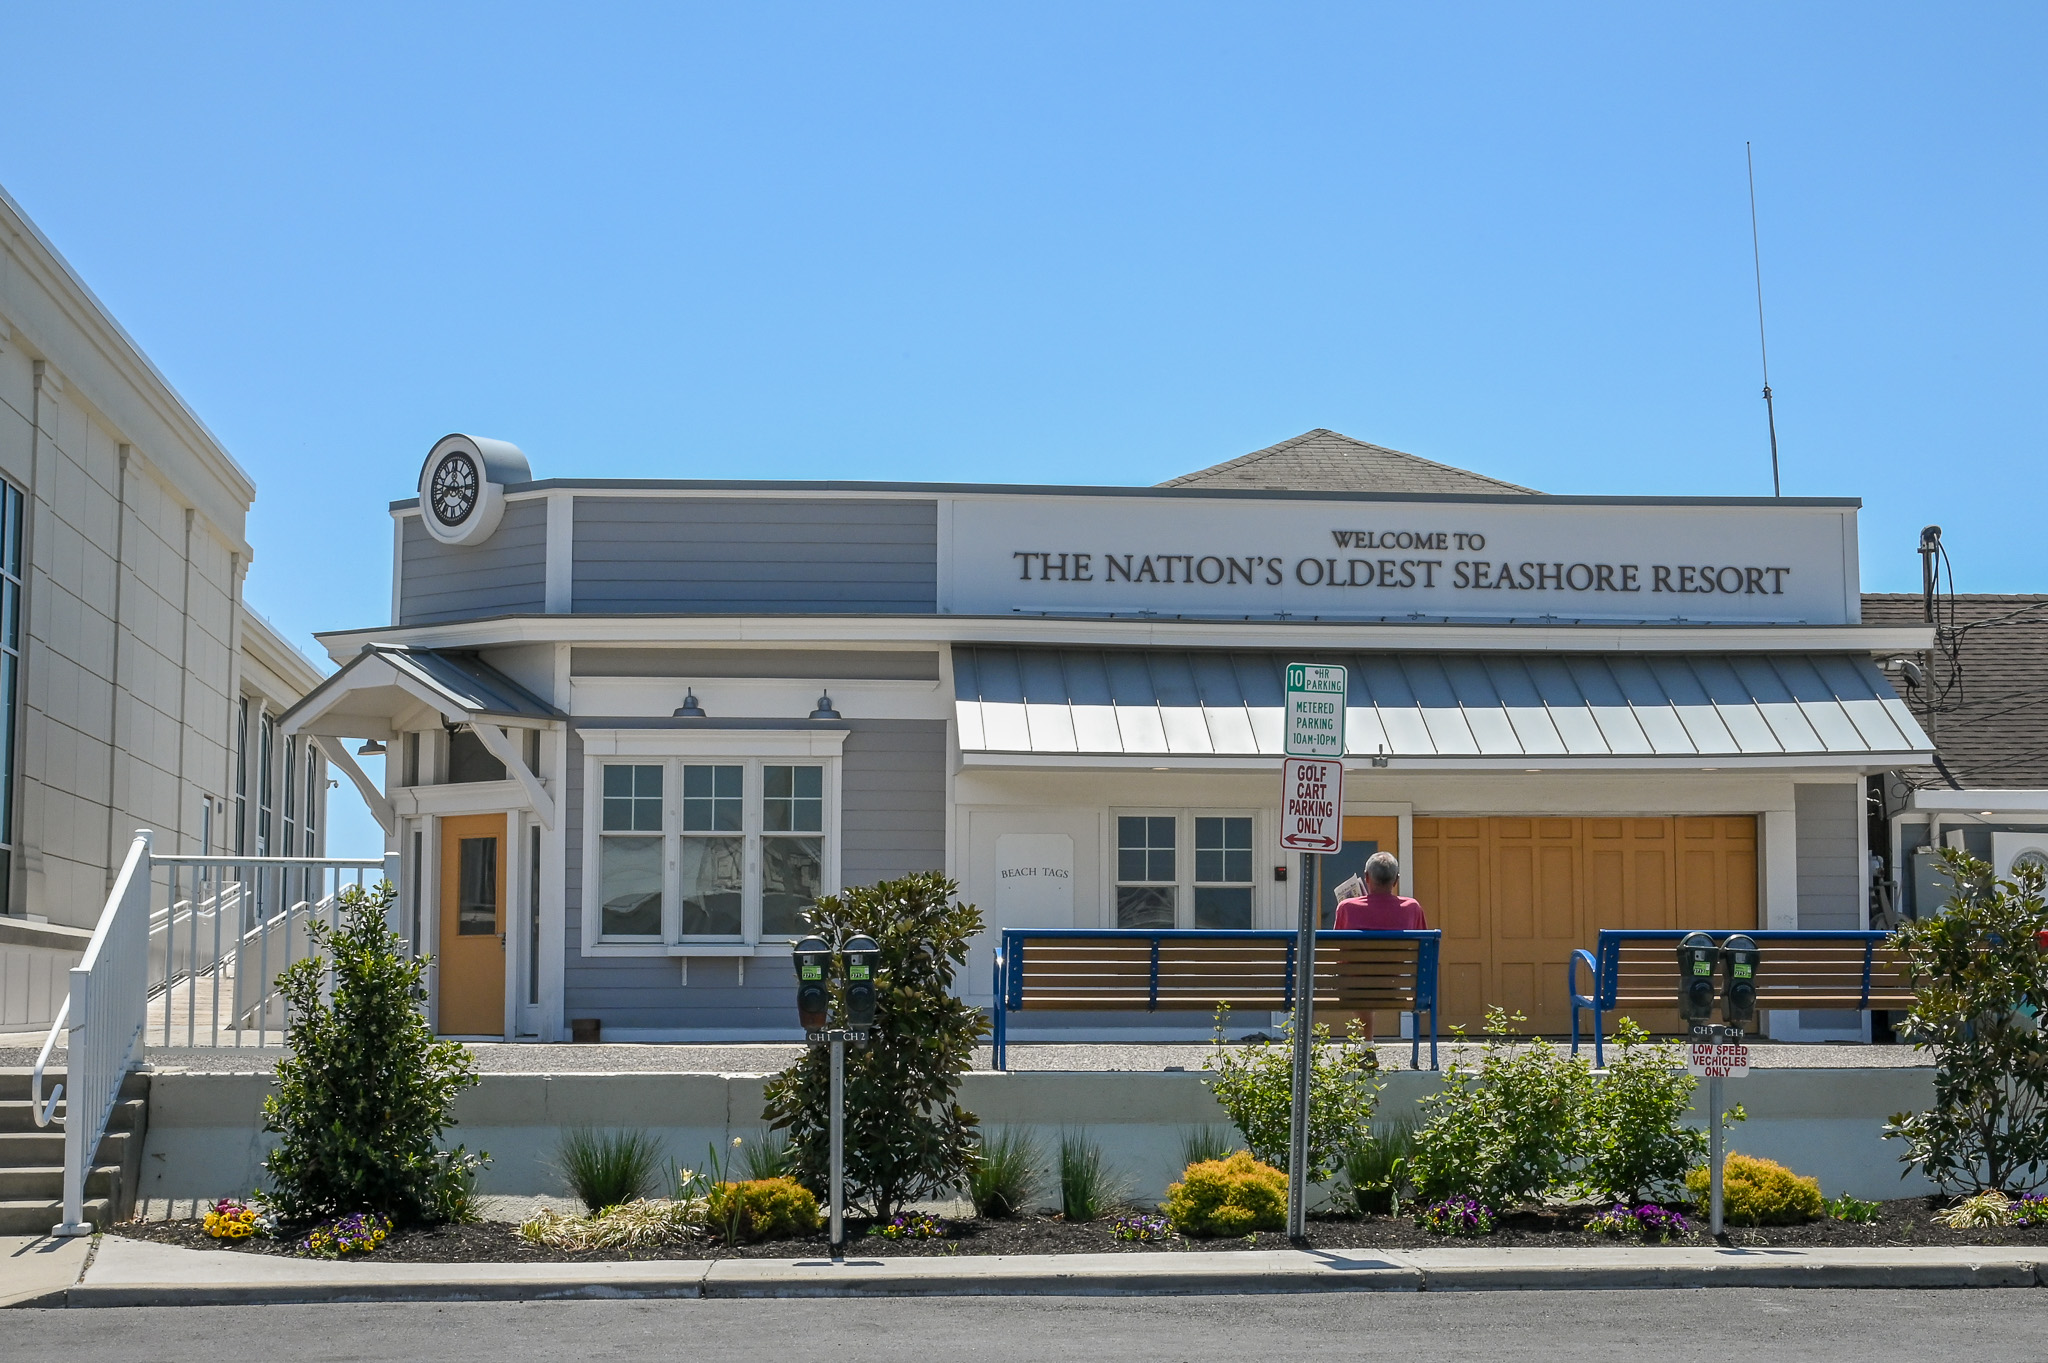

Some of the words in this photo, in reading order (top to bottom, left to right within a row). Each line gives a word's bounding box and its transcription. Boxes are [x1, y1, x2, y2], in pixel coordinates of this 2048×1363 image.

[1331, 530, 1449, 551] WELCOME
[1453, 532, 1486, 551] TO
[1013, 551, 1094, 582] THE
[1105, 554, 1283, 586] NATION'S
[1295, 557, 1442, 588] OLDEST
[1453, 560, 1641, 592] SEASHORE
[1652, 565, 1790, 595] RESORT
[1289, 669, 1303, 687] 10
[1318, 668, 1330, 679] HR
[1306, 679, 1342, 691] PARKING
[1296, 701, 1335, 715] METERED
[1296, 716, 1334, 730] PARKING
[1293, 732, 1337, 746] 10AM-10PM
[1297, 764, 1327, 782] GOLF
[1296, 782, 1327, 800] CART
[1288, 799, 1333, 818] PARKING
[1296, 817, 1324, 835] ONLY
[1001, 867, 1037, 879] BEACH
[1042, 867, 1069, 879] TAGS
[809, 1032, 825, 1041] CH
[843, 1032, 858, 1041] CH
[860, 1032, 866, 1041] 2
[1693, 1026, 1708, 1035] CH
[1709, 1027, 1714, 1035] 3
[1724, 1028, 1738, 1037] CH
[1739, 1028, 1744, 1037] 4
[1692, 1044, 1713, 1055] LOW
[1716, 1045, 1748, 1056] SPEED
[1692, 1055, 1747, 1067] VECHICLES
[1704, 1066, 1730, 1077] ONLY
